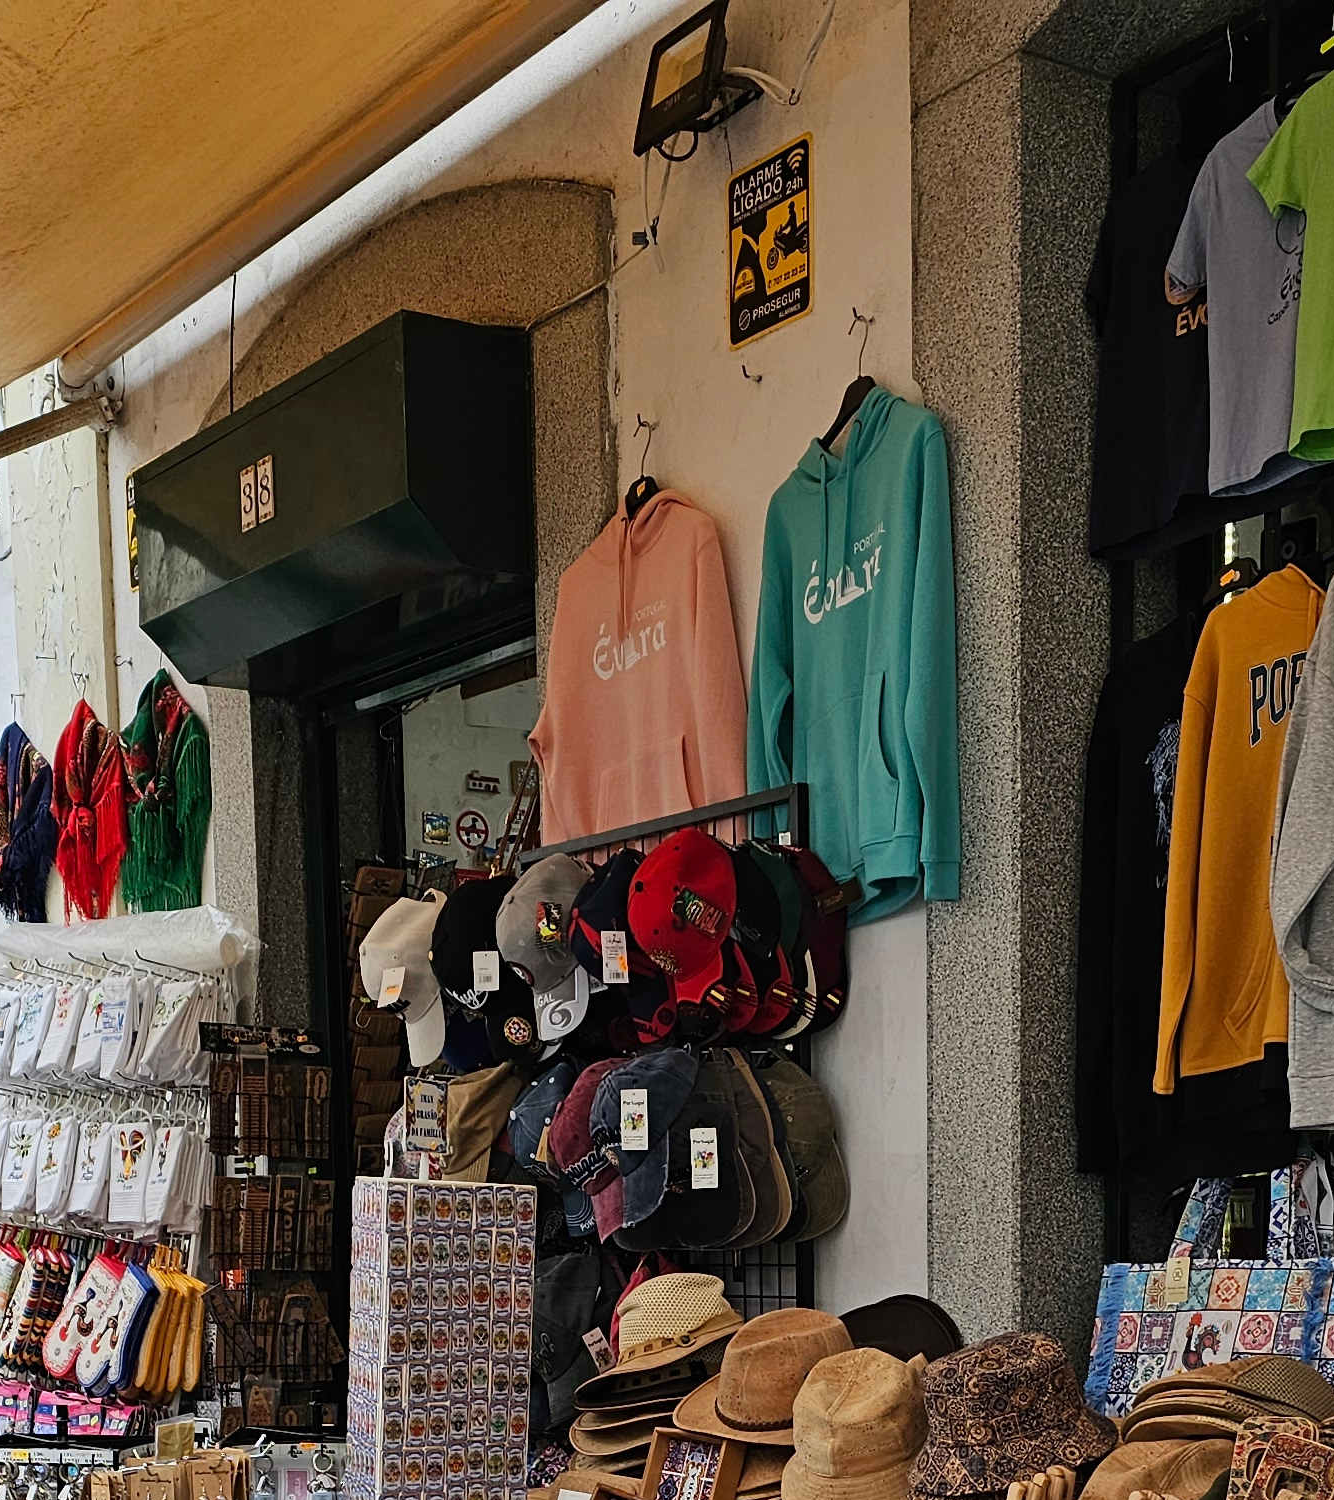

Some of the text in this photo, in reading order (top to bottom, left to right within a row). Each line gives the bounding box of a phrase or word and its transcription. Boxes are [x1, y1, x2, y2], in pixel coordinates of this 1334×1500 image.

[733, 159, 782, 199] ALARME
[733, 175, 803, 217] LIGADO 24h
[752, 288, 801, 321] PROSEGUR
[242, 467, 272, 516] 38
